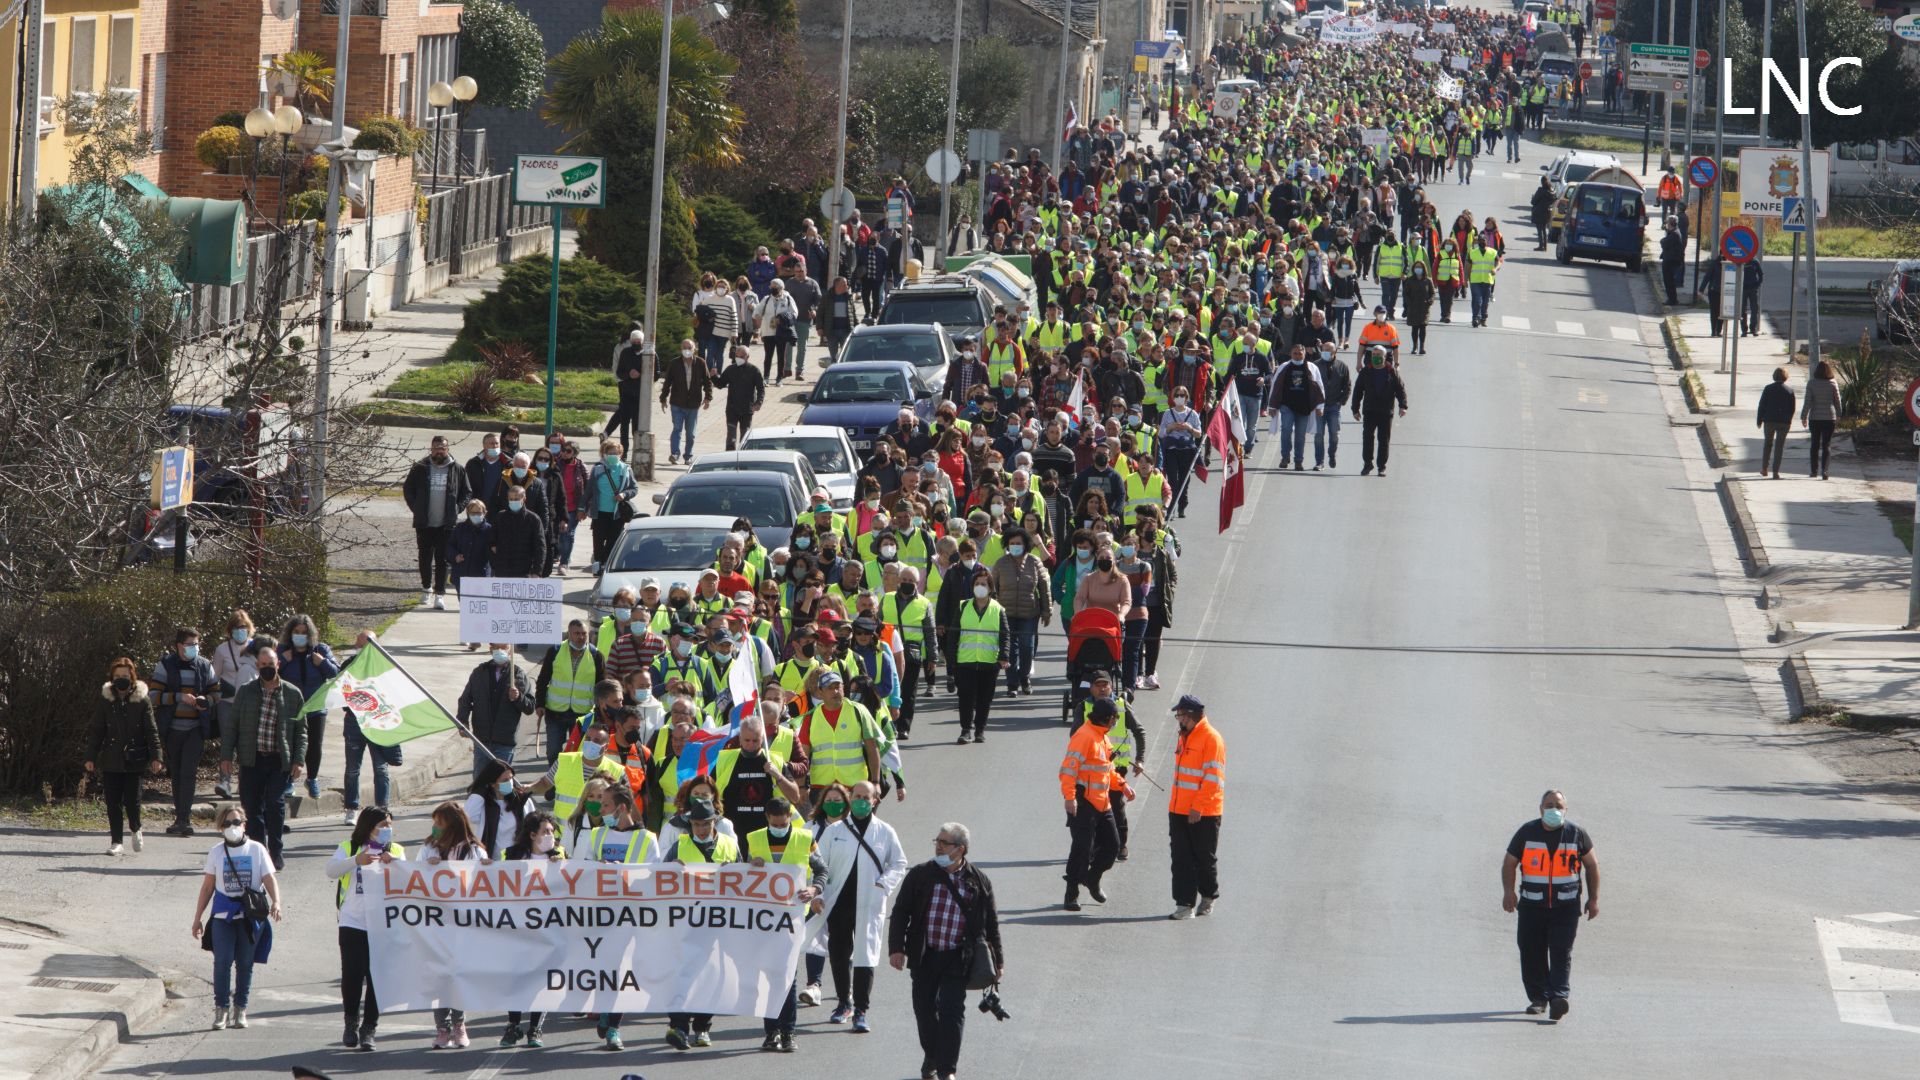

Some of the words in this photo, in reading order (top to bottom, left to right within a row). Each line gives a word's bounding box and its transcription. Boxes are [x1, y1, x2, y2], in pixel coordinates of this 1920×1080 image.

[1640, 46, 1688, 55] CUATROVIENTOS
[521, 160, 558, 169] FLORES
[491, 581, 555, 599] SANIDAD
[469, 601, 488, 615] NO
[511, 601, 556, 615] VENDE
[491, 619, 553, 634] DEFIENDE
[384, 868, 551, 898] LACIANA
[560, 868, 584, 896] Y
[597, 869, 643, 897] EL
[656, 870, 795, 901] BIERZO
[385, 904, 444, 928] POR
[454, 908, 517, 929] UNA
[525, 905, 658, 929] SANIDAD
[669, 901, 795, 934] PÚBLICA
[584, 937, 603, 959] Y
[547, 969, 640, 991] DIGNA
